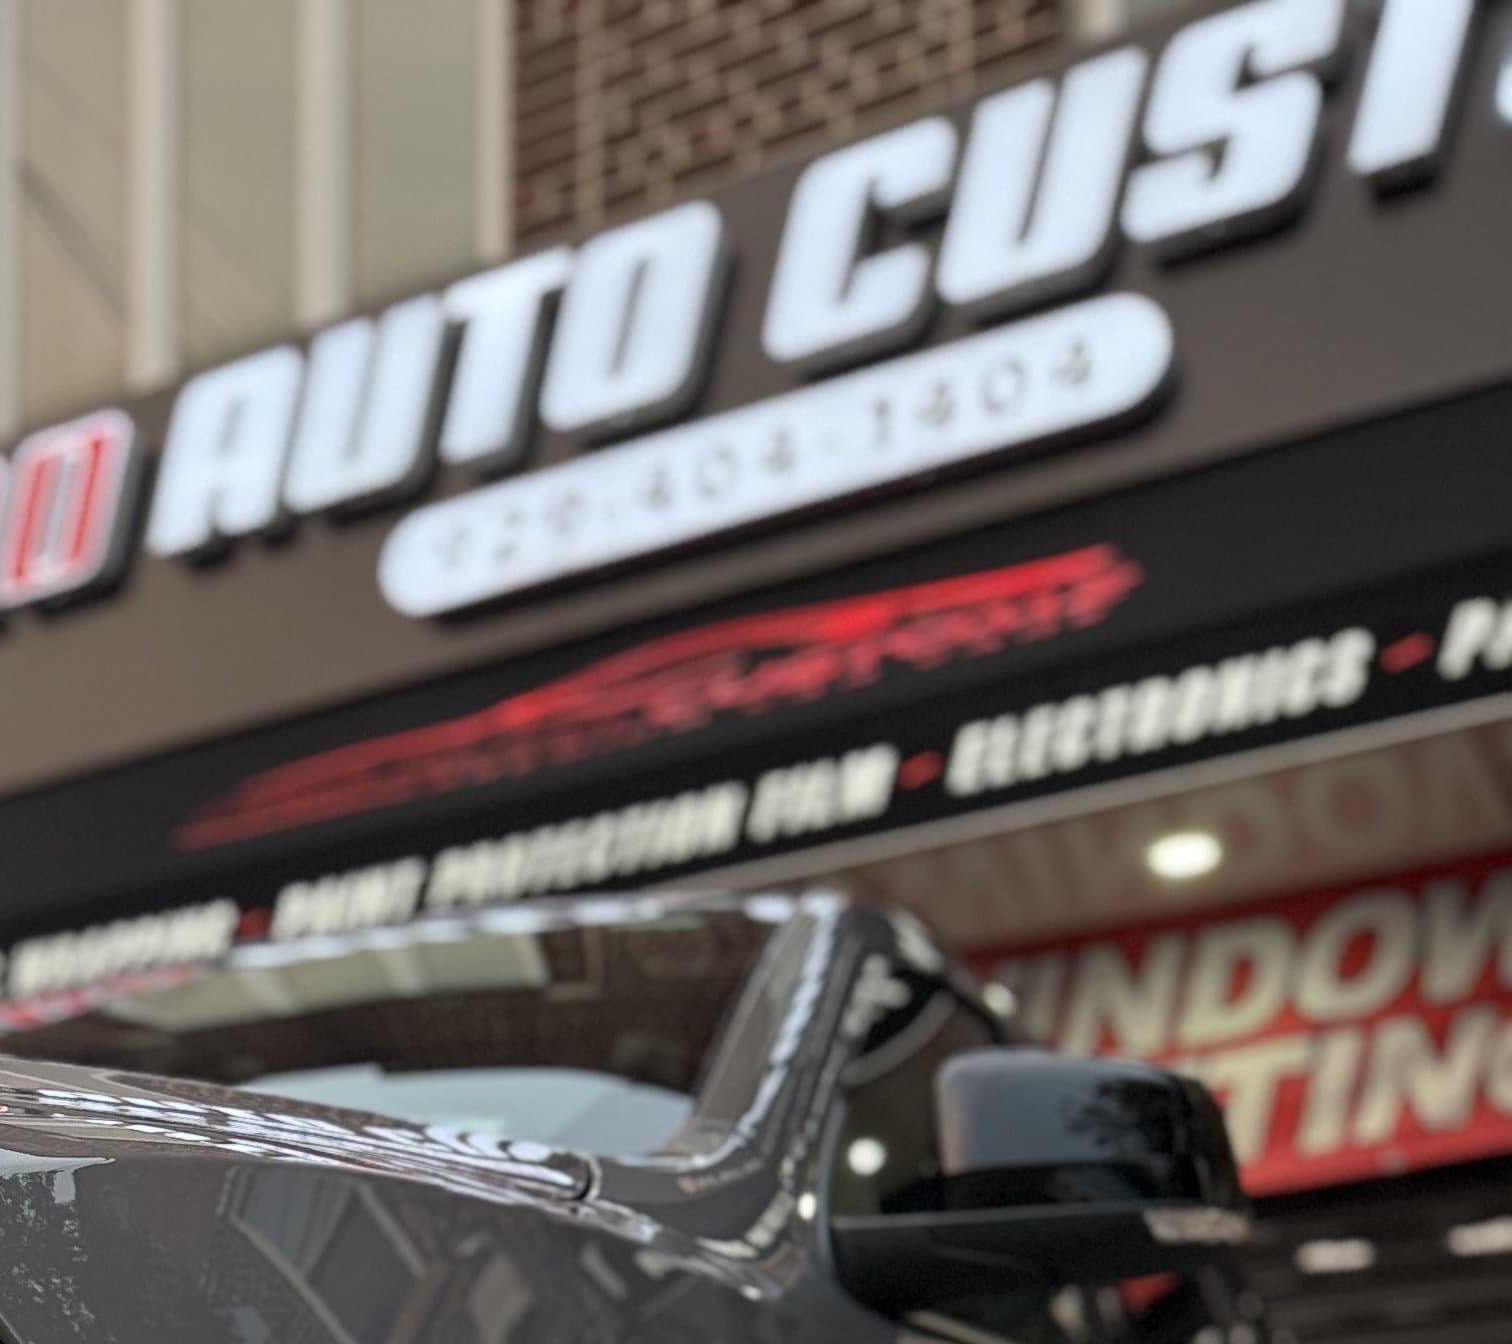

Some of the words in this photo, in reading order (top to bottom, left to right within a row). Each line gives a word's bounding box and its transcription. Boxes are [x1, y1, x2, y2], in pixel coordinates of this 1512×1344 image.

[148, 202, 726, 557] AUTO
[762, 0, 1512, 361] CUST
[945, 627, 1377, 798] ELECTRONICS
[993, 868, 1512, 1060] INDOW
